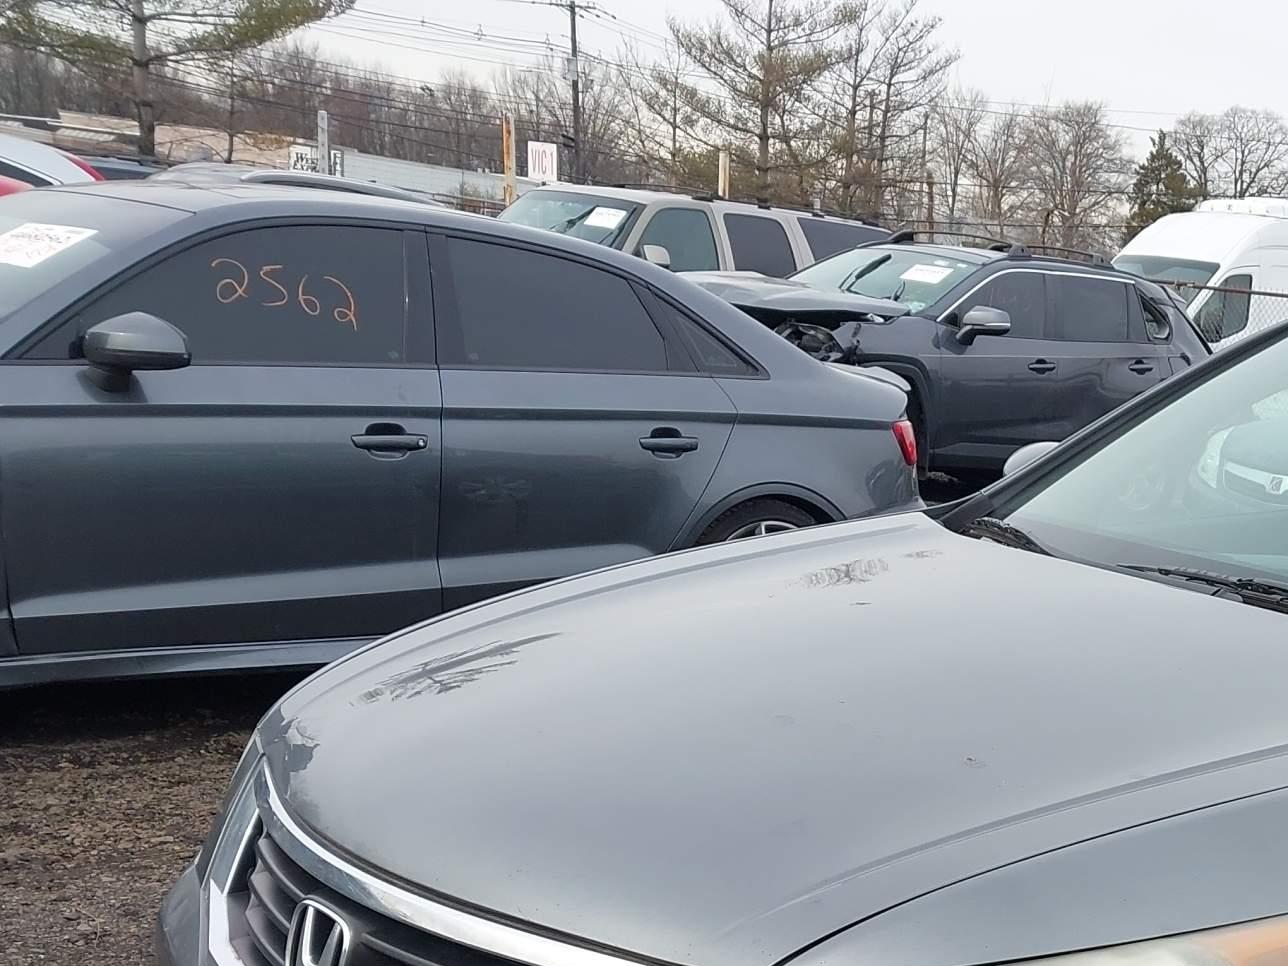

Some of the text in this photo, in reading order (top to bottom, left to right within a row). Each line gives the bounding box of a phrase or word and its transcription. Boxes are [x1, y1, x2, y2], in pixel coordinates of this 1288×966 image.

[531, 149, 554, 176] VIC 1
[211, 258, 357, 331] 2562
